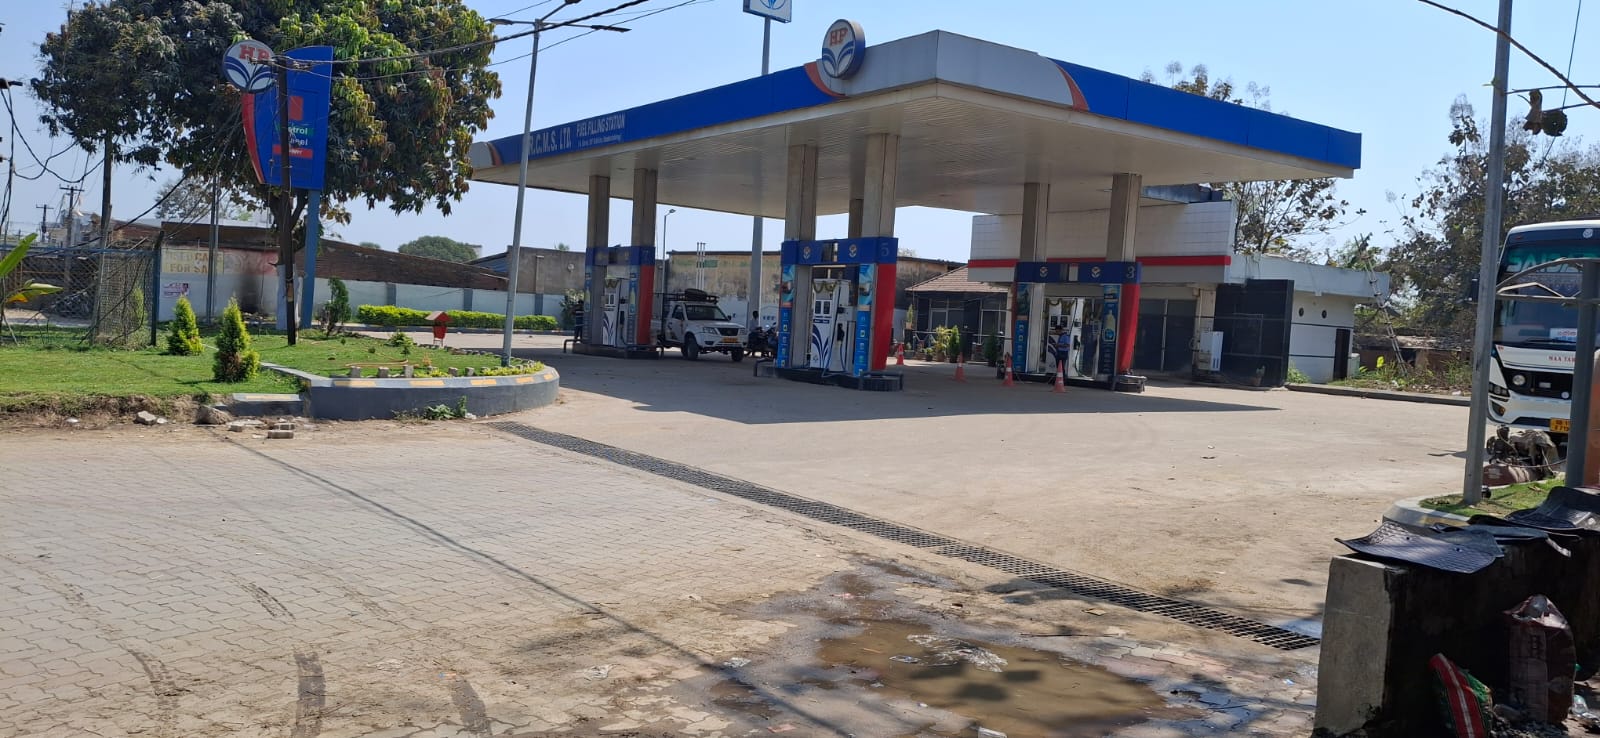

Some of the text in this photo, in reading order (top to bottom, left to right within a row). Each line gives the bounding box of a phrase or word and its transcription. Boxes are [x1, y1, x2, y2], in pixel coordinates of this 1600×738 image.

[829, 27, 848, 47] HP
[238, 44, 270, 60] HP
[287, 126, 308, 135] etrol
[881, 242, 890, 257] 5
[1126, 265, 1136, 279] 3
